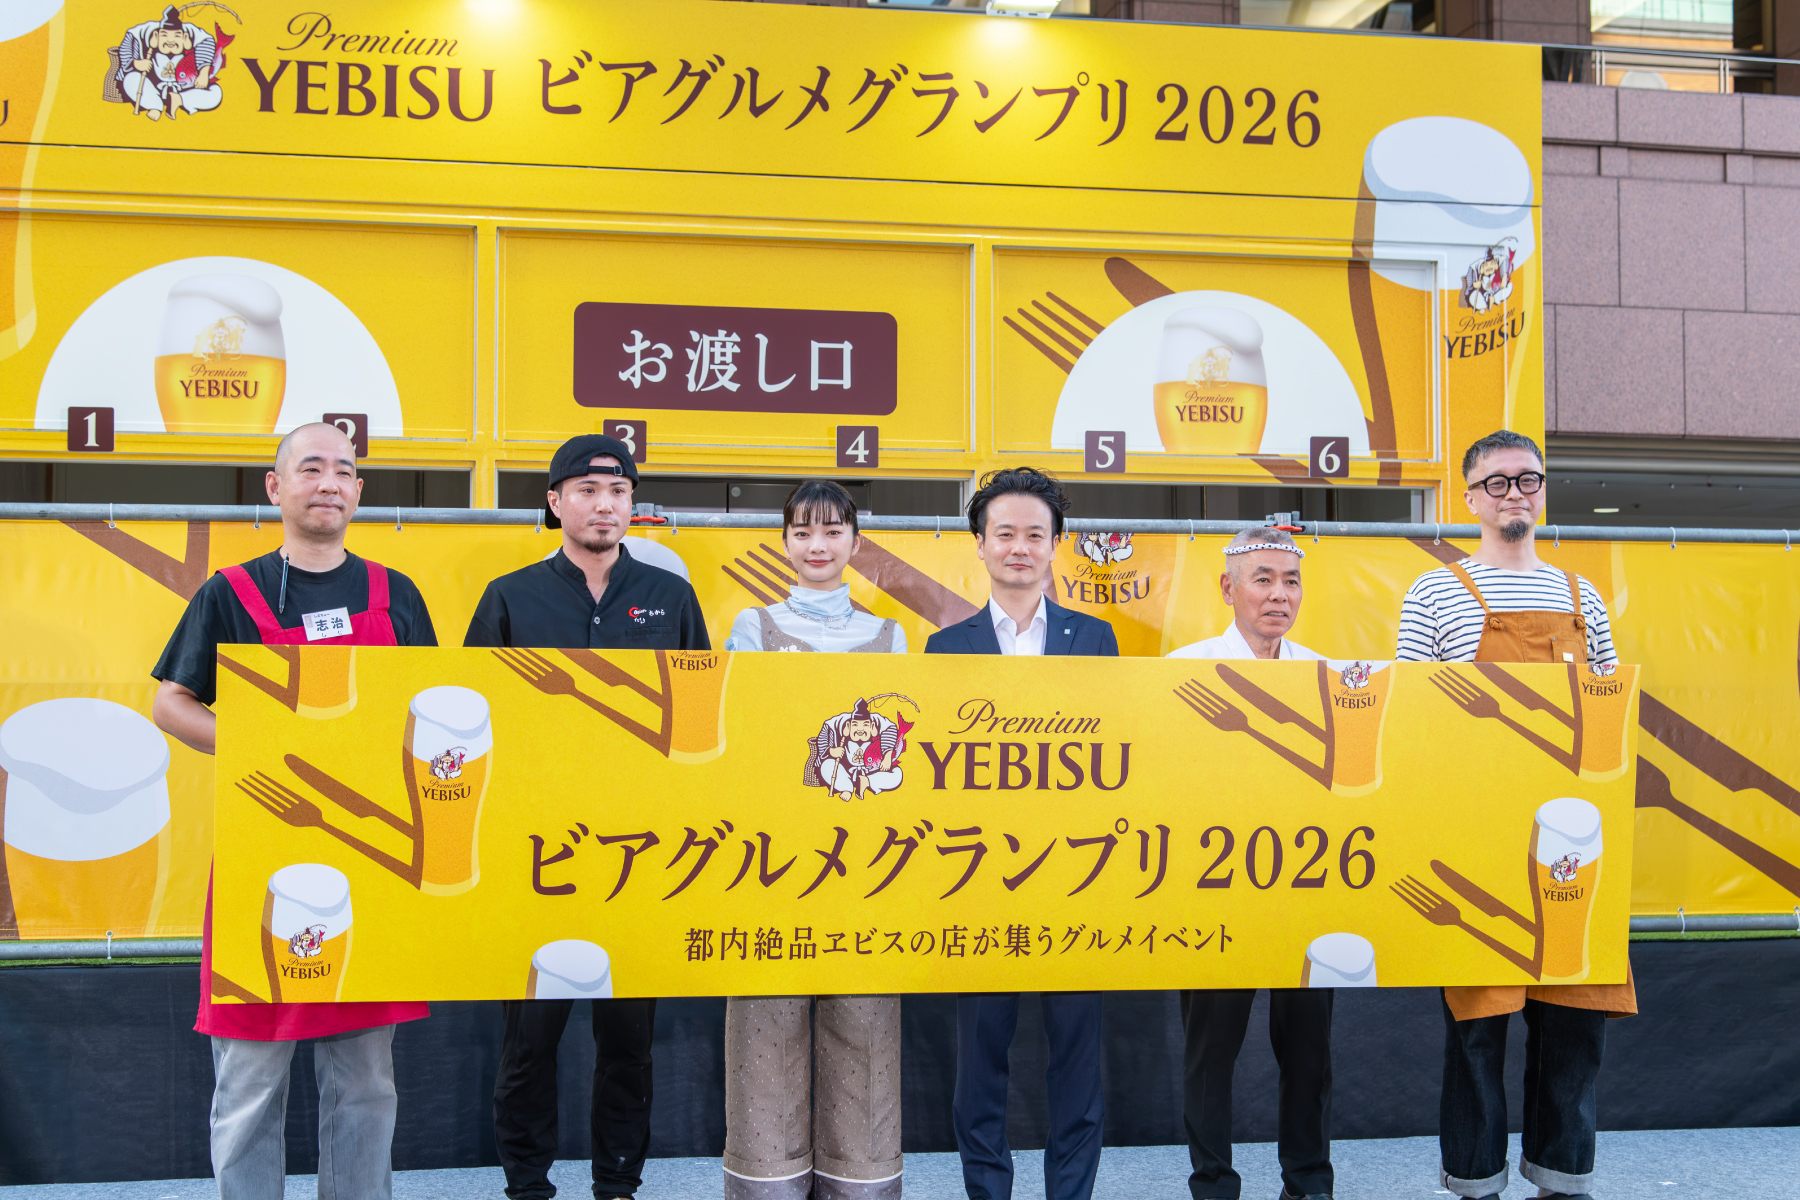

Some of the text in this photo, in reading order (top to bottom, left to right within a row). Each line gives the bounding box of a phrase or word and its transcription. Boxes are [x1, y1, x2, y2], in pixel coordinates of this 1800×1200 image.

[276, 12, 458, 57] Premium
[240, 53, 496, 122] YEBISU
[538, 49, 1321, 148] ビアグルメグランプリ 2026
[1443, 310, 1525, 359] YEBISU
[1455, 307, 1516, 334] Premium
[188, 363, 248, 378] Premium
[618, 329, 853, 393] お渡し口
[179, 379, 259, 399] YEBISU
[1183, 390, 1235, 403] Premium
[83, 412, 100, 447] 1
[1175, 405, 1245, 424] YEBISU
[615, 424, 636, 456] 3
[845, 430, 869, 464] 4
[1095, 435, 1115, 469] 5
[1318, 440, 1341, 474] 6
[1073, 564, 1137, 580] Premium
[1061, 575, 1150, 604] YEBISU
[315, 617, 344, 631] 志治
[670, 655, 718, 671] YEBISU
[1333, 694, 1376, 709] YEBISU
[1582, 682, 1623, 696] YEBISU
[948, 698, 1101, 736] Premium
[917, 741, 1131, 791] YEBISU
[421, 786, 471, 801] YEBISU
[528, 817, 1376, 903] ビアグルメグランプリ 2026
[1543, 888, 1584, 902] YEBISU
[684, 923, 1233, 962] 都内絶品ヱビスの店が集うグルメイベント
[280, 963, 331, 979] YEBISU
